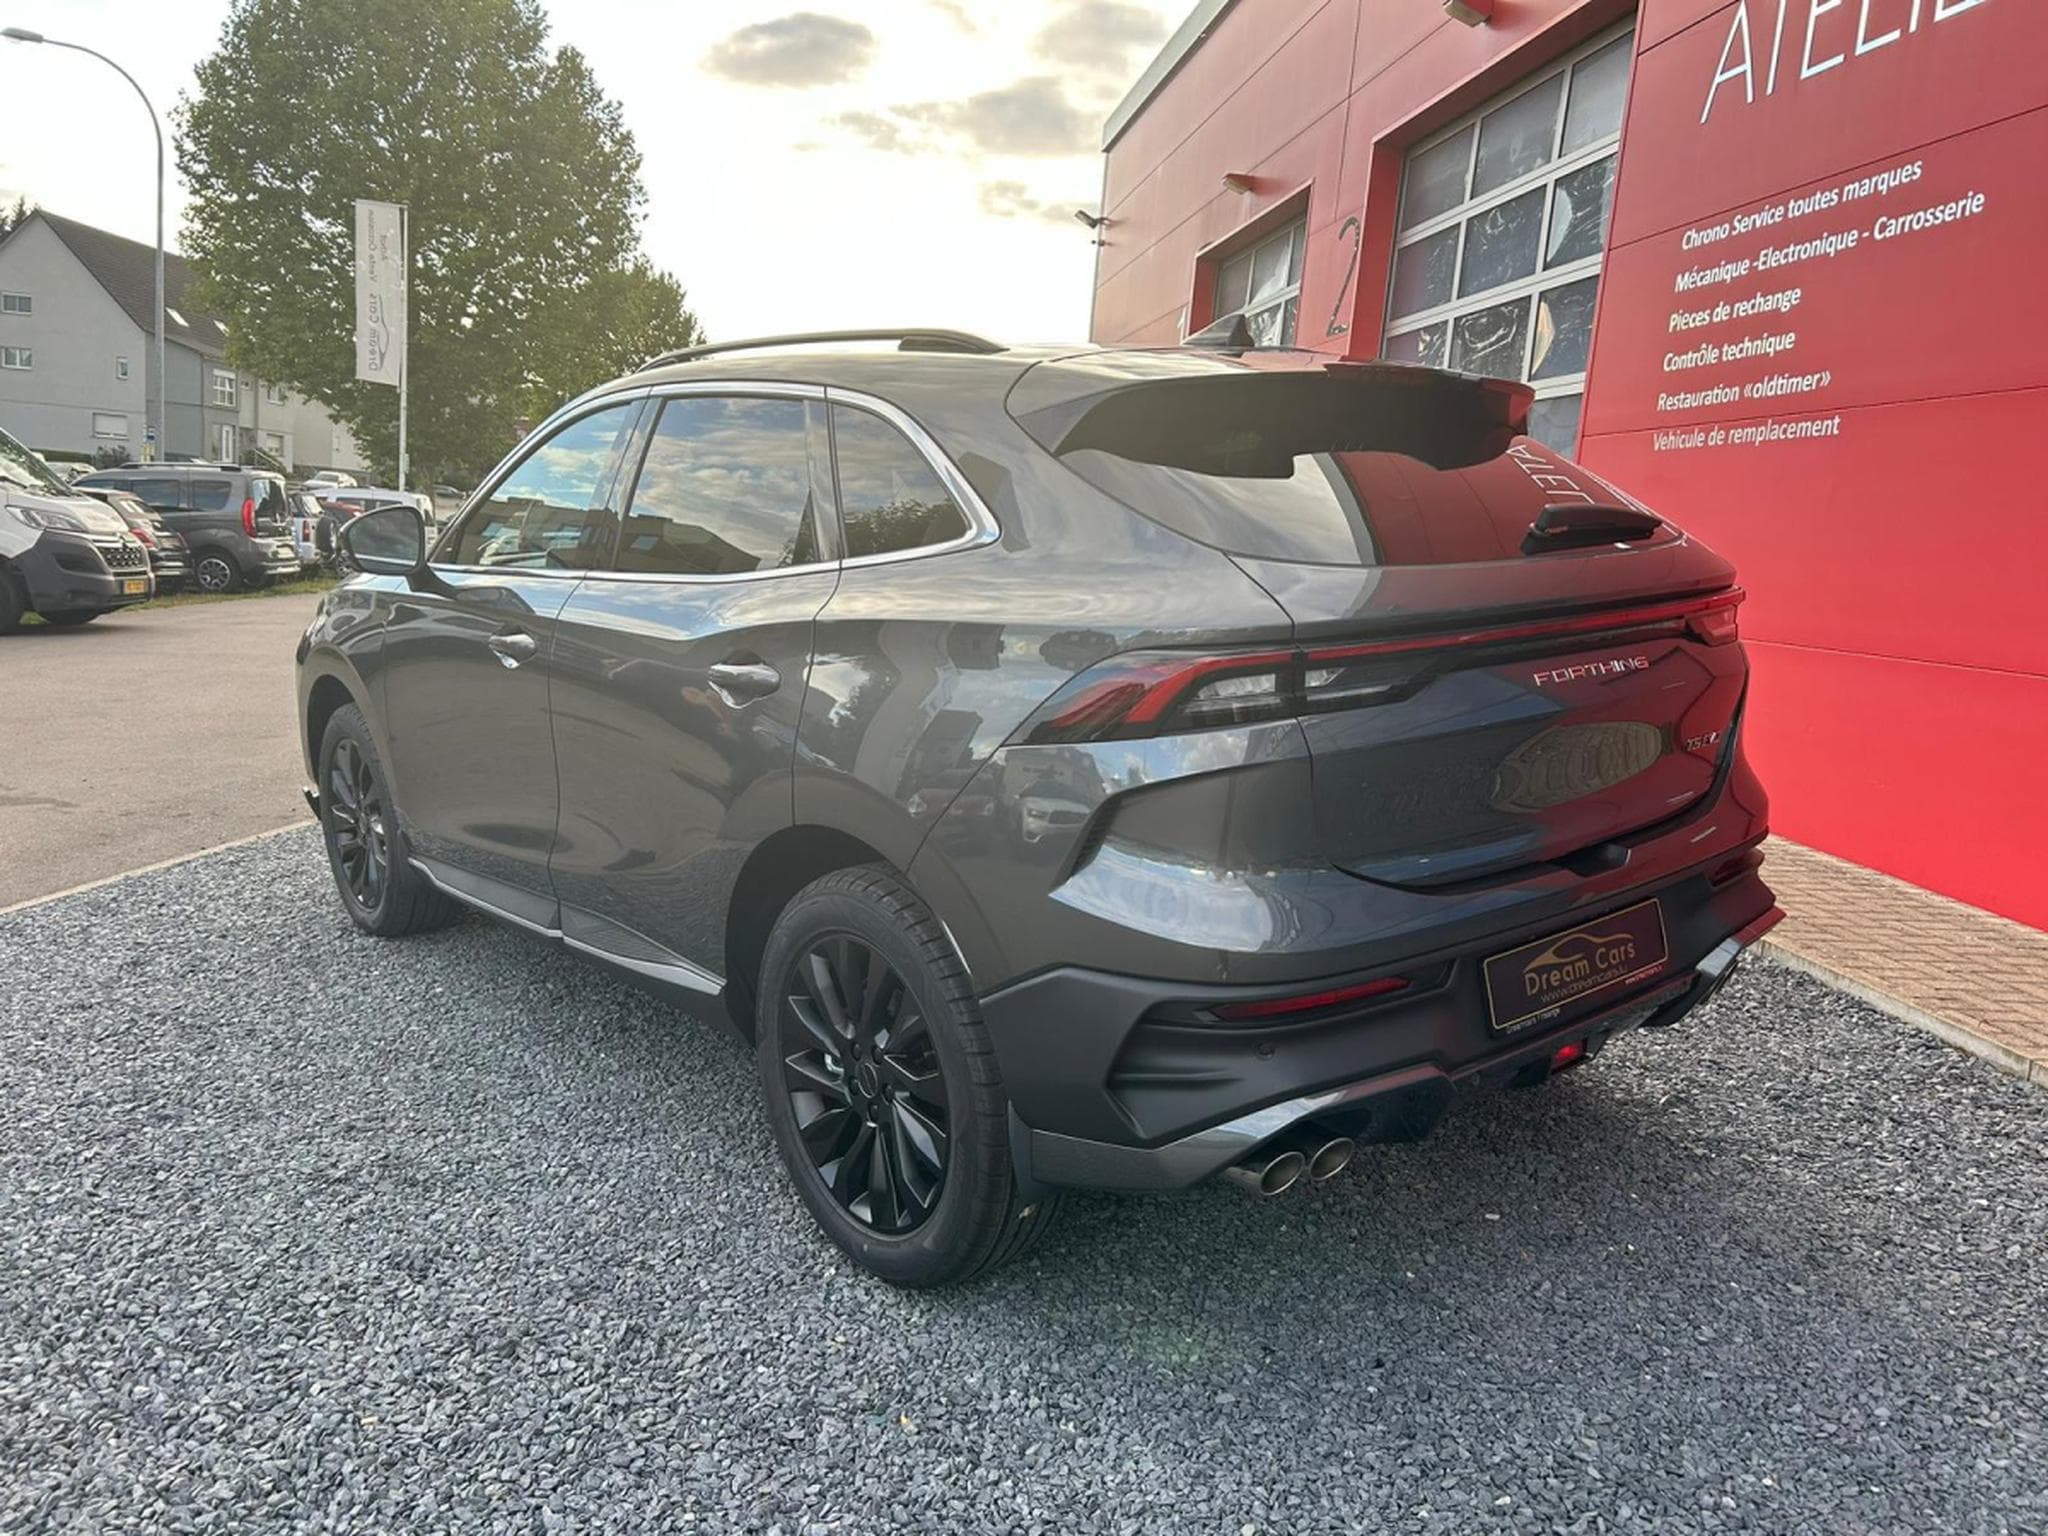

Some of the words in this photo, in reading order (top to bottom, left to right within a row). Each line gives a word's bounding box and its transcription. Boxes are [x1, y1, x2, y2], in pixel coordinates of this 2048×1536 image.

[1682, 222, 1730, 251] Chrono
[1732, 205, 1784, 237] Service
[1787, 185, 1839, 220] toutes
[1843, 159, 1923, 204] marques
[1674, 256, 1750, 293] Mécanique
[1873, 190, 1985, 242] Carrosserie
[1712, 301, 1730, 323] de
[1732, 287, 1802, 319] rechange
[1663, 343, 1720, 372] Contrôle
[1722, 331, 1796, 363] technique
[1656, 383, 1740, 412] Restauration
[1707, 425, 1725, 446] de
[1728, 414, 1841, 446] remplacement
[1533, 655, 1650, 687] FORTHING
[1523, 959, 1591, 997] Dream
[1595, 941, 1637, 969] Cars
